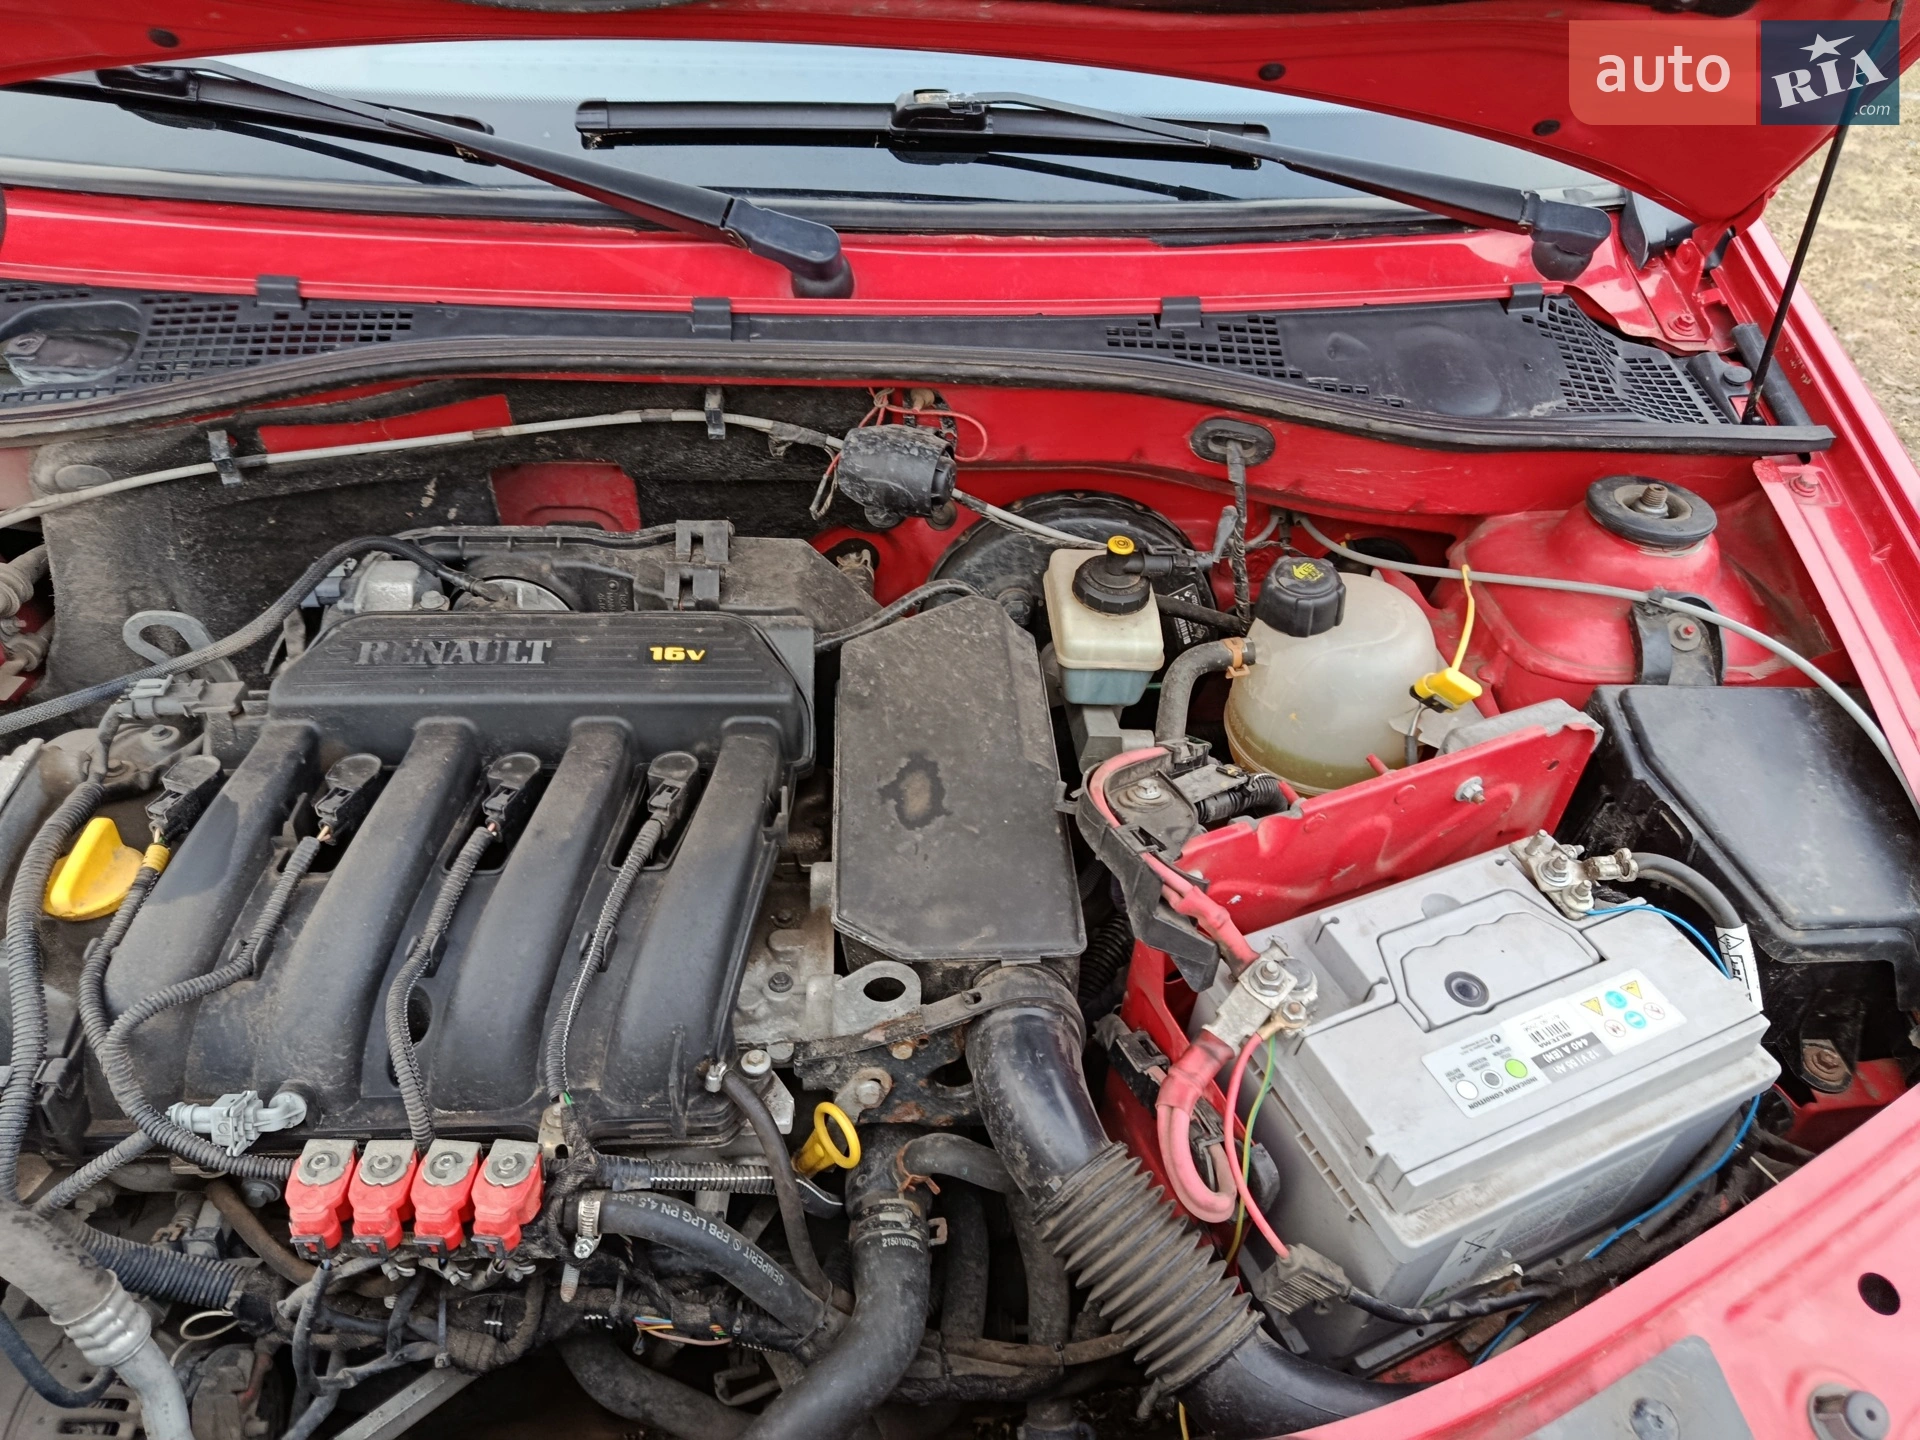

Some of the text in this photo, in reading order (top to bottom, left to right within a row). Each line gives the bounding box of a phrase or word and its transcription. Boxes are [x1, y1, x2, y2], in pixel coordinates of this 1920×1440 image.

[354, 640, 552, 665] RENAULT
[1467, 1076, 1538, 1110] INDICATOR CONDITION
[660, 1202, 681, 1219] PN
[682, 1210, 707, 1232] LPG
[708, 1223, 731, 1245] FPB
